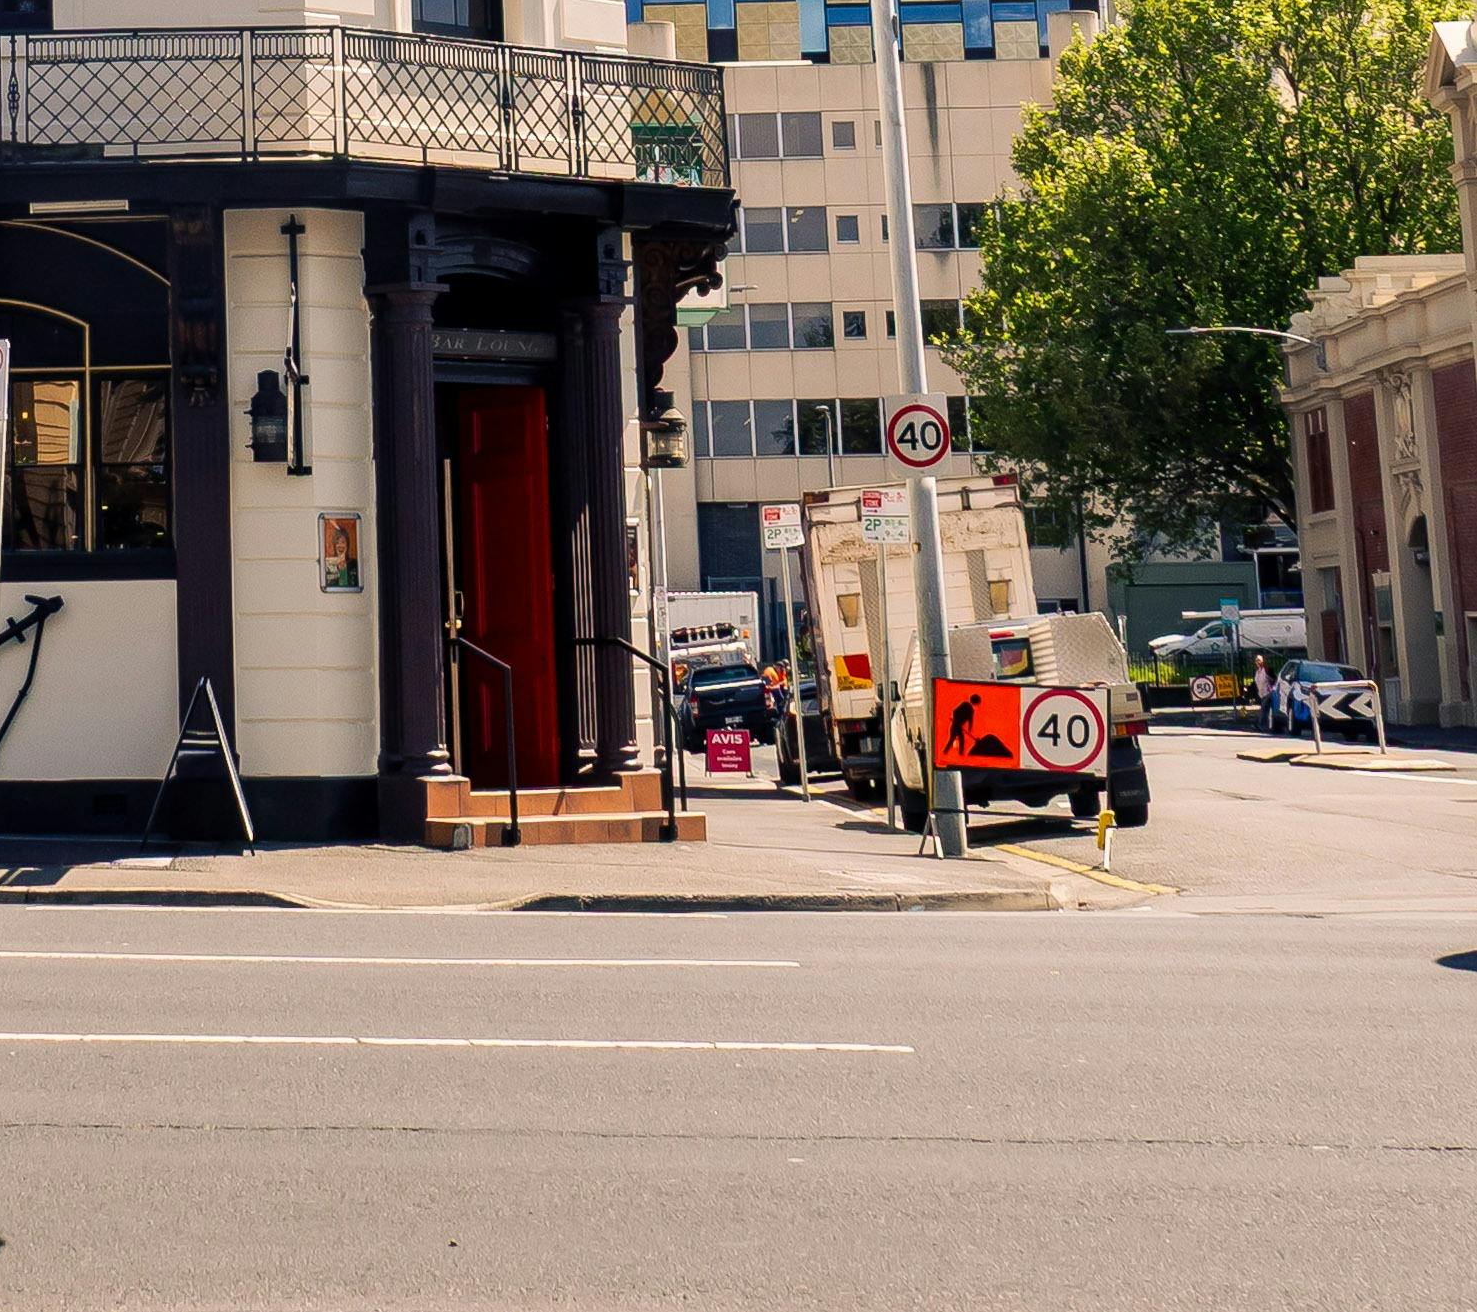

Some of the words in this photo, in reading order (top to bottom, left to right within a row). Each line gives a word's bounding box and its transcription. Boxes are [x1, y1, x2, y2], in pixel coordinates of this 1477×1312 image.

[896, 420, 942, 451] 40
[864, 518, 882, 532] 2P
[767, 528, 782, 540] 2P
[1196, 682, 1211, 694] 50
[1036, 713, 1091, 749] 40
[711, 733, 743, 745] AVIS
